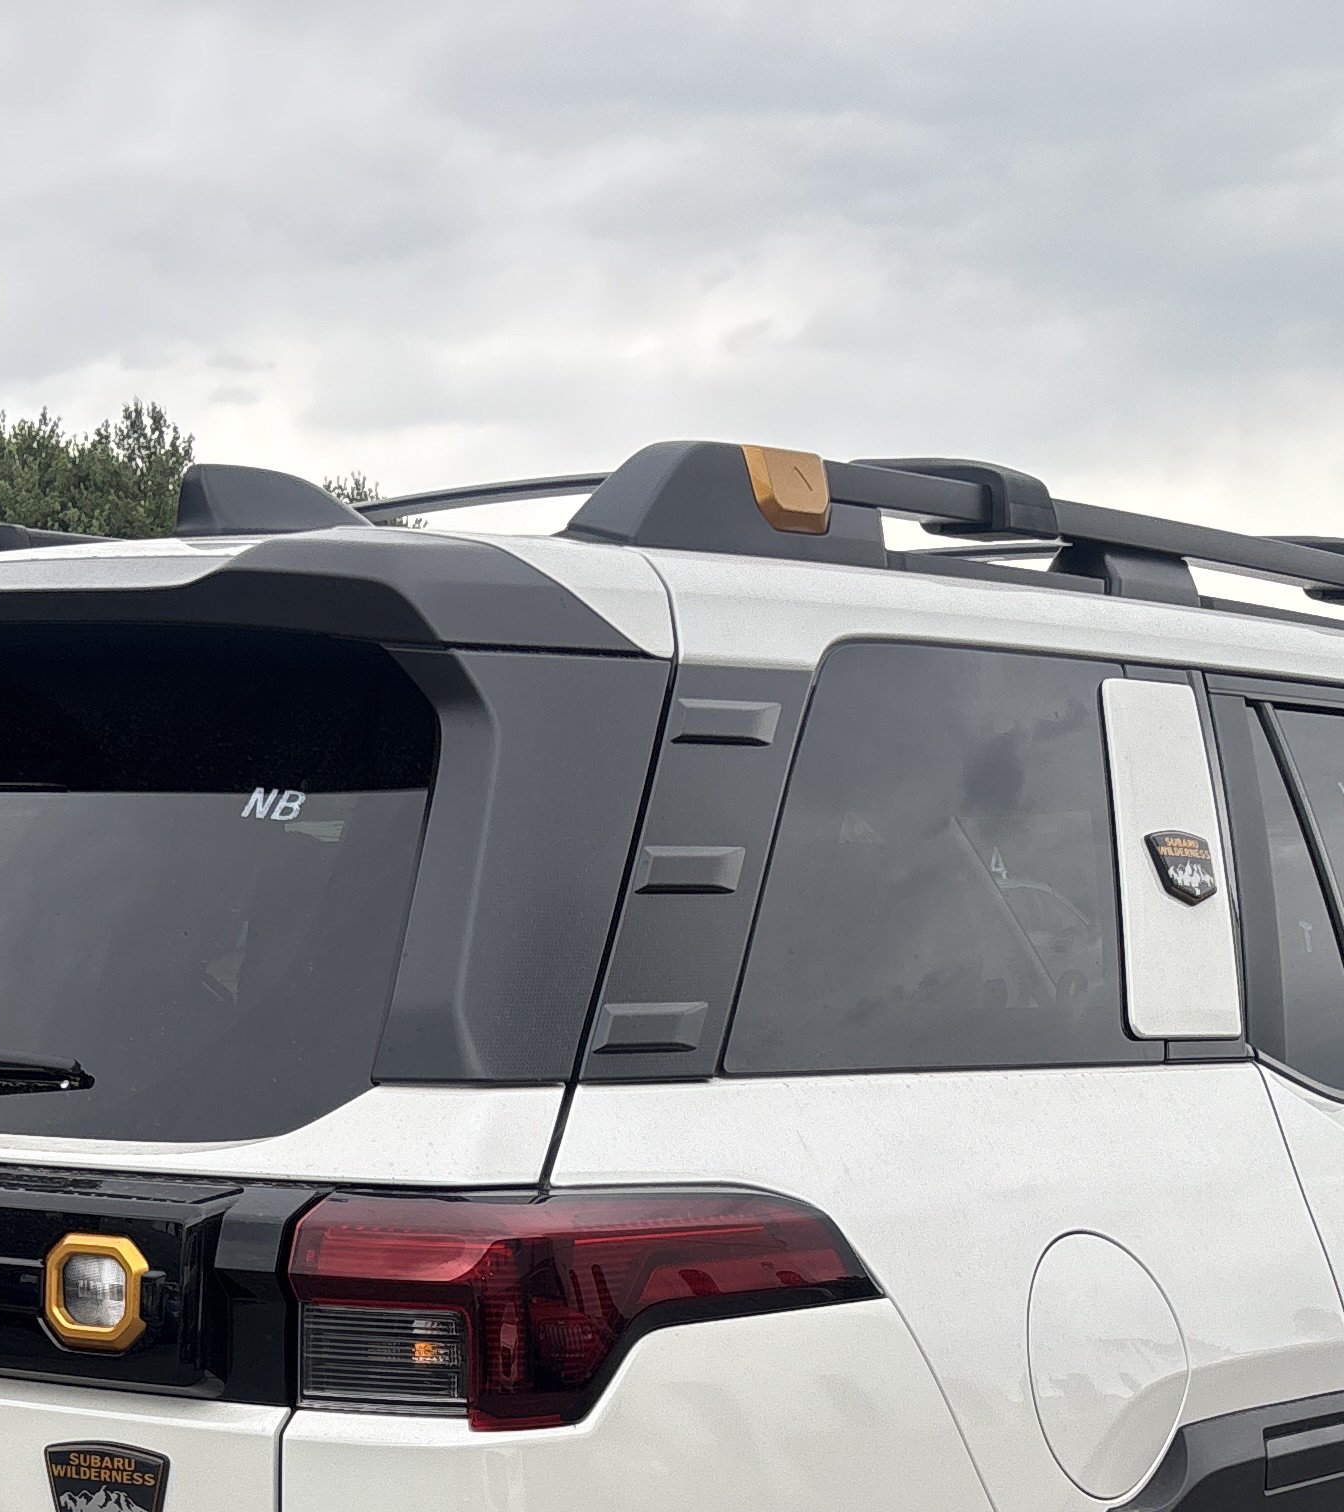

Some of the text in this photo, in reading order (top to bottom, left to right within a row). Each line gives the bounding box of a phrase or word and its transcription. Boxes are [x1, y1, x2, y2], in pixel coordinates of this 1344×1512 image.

[240, 786, 306, 821] NB
[1165, 837, 1199, 848] SUBARU
[1157, 847, 1210, 859] WILDERNESS
[69, 1453, 135, 1471] SUBARU
[52, 1464, 155, 1486] WILDERNESS
